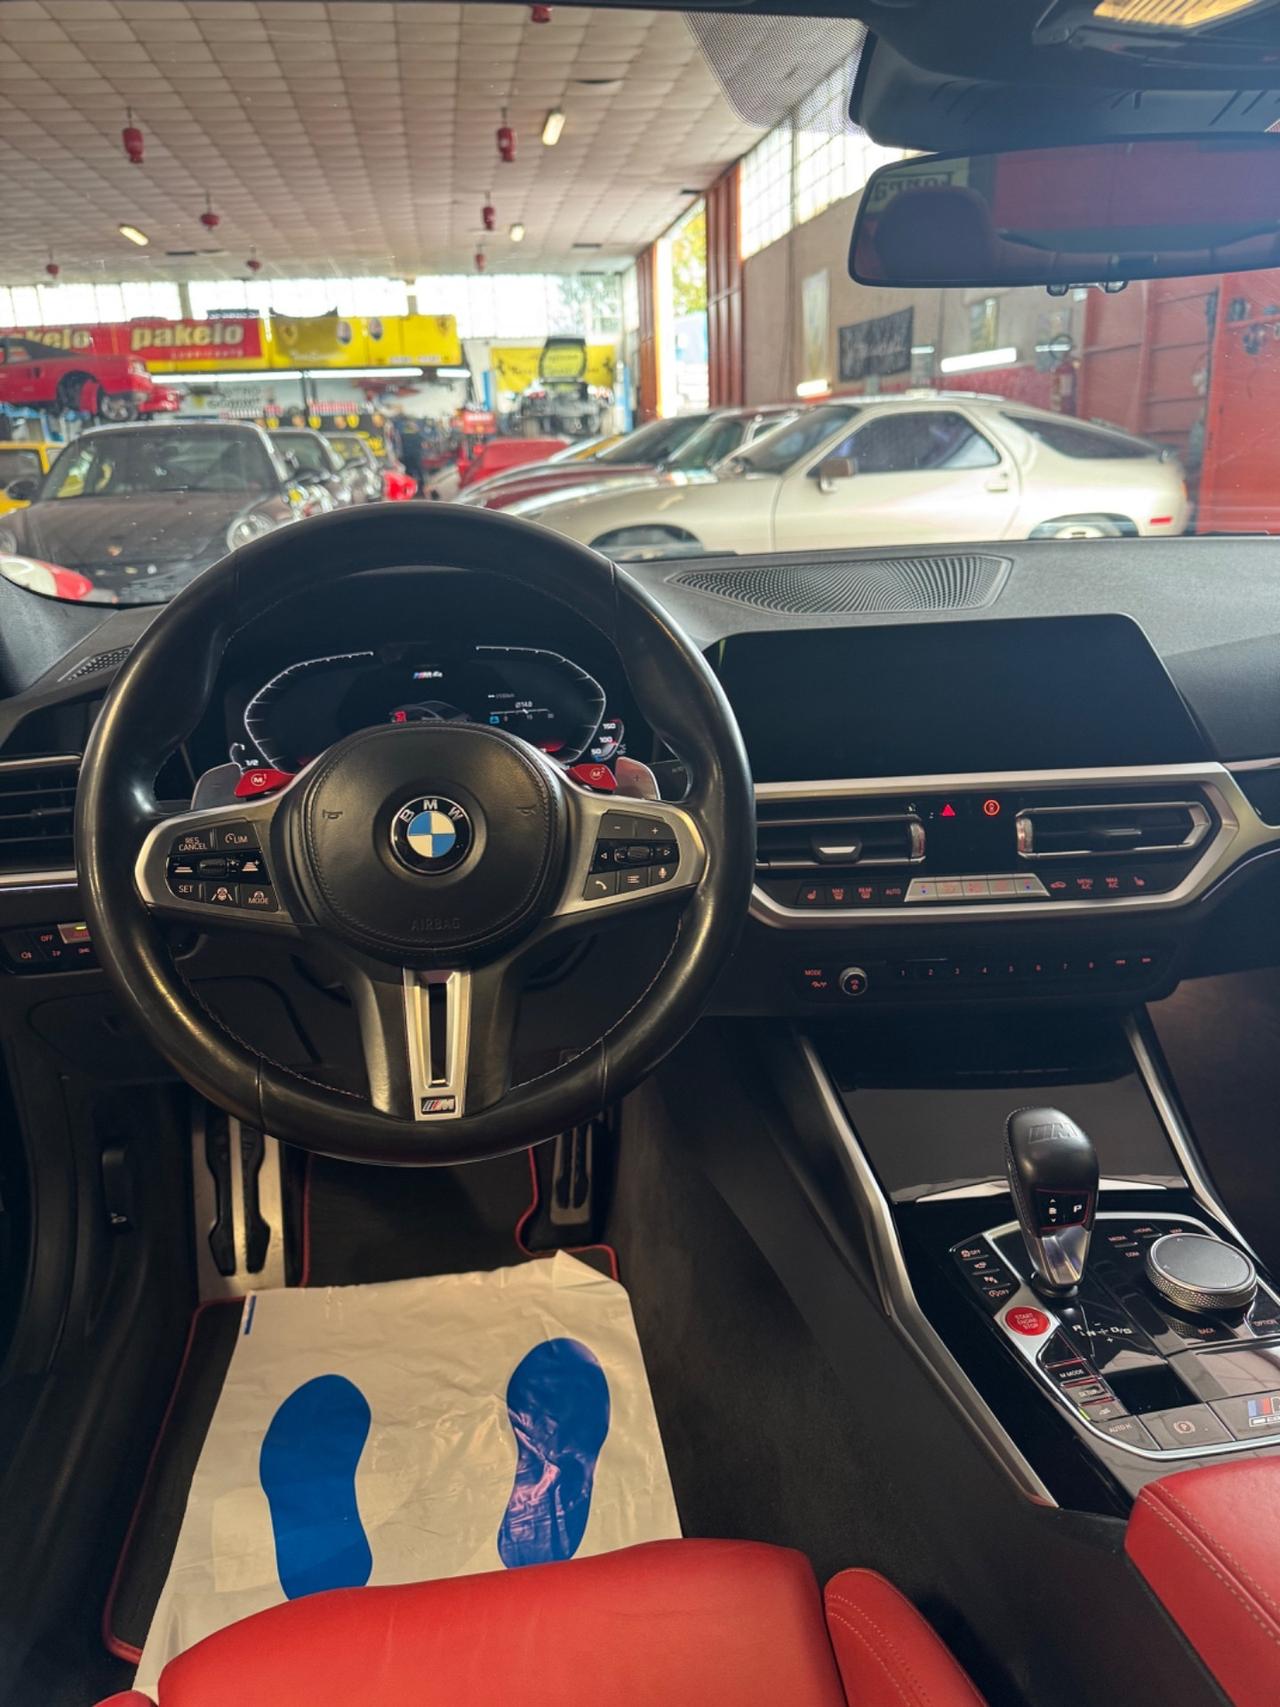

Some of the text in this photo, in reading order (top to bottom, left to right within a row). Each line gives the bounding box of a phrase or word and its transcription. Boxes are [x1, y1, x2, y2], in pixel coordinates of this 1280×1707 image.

[130, 322, 244, 351] pakelo
[602, 722, 616, 730] 150
[399, 799, 464, 823] BMW
[178, 843, 208, 852] CANCEL
[178, 885, 193, 893] SET
[410, 917, 461, 932] AIRBAG
[1073, 1204, 1082, 1213] P
[1014, 1312, 1034, 1320] START
[1252, 1319, 1279, 1327] OPTION
[1198, 1327, 1215, 1335] BACK
[1067, 1368, 1085, 1377] MODE
[1108, 1424, 1126, 1433] AUTO
